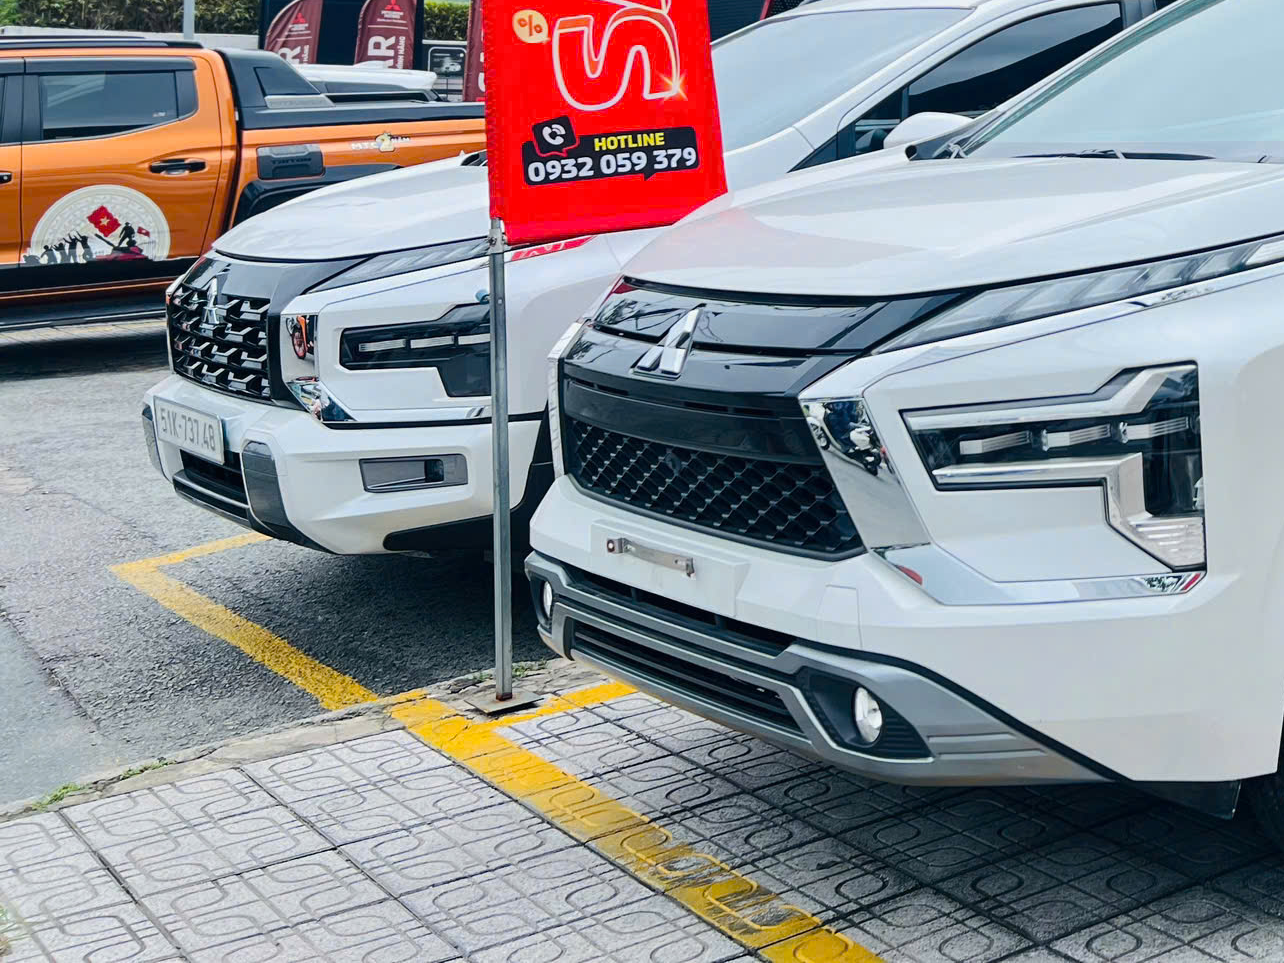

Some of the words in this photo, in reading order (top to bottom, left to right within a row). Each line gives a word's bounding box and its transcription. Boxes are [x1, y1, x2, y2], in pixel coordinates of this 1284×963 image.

[593, 133, 665, 151] HOTLINE
[527, 156, 595, 182] 0932
[600, 151, 647, 174] 059
[652, 147, 697, 169] 379
